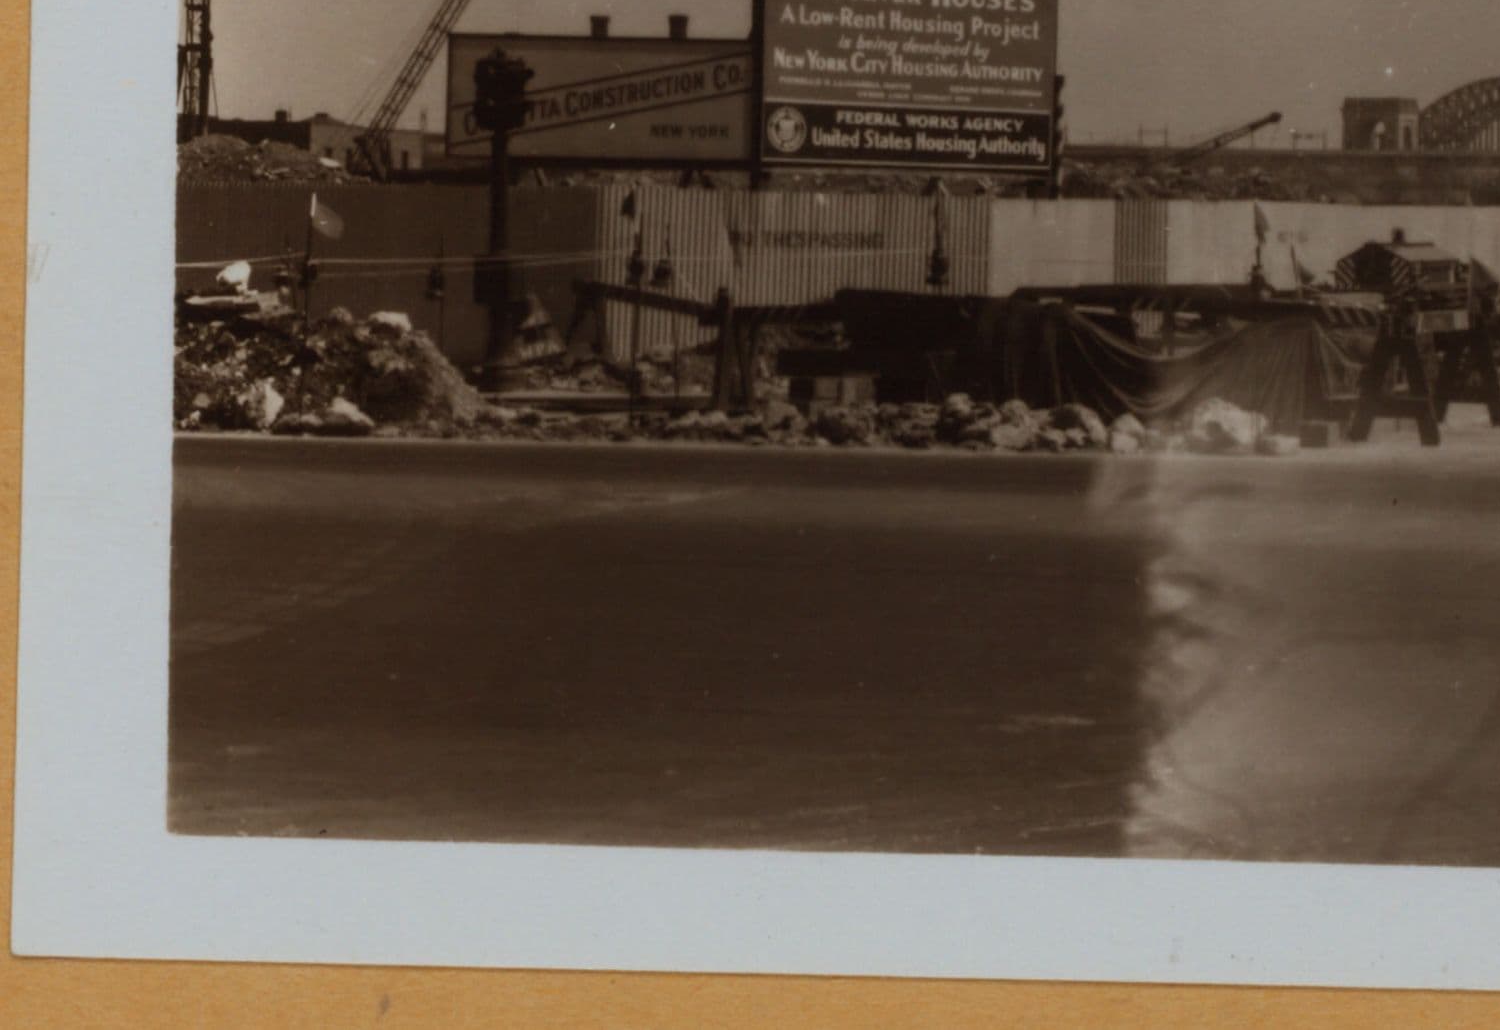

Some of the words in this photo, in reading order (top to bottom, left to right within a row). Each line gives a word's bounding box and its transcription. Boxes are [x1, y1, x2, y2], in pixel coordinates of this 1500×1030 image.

[781, 5, 795, 23] A
[800, 6, 885, 29] Low-Rent
[890, 9, 964, 40] Housing
[971, 17, 1040, 45] Project
[774, 47, 804, 69] NEW
[808, 51, 848, 71] YORK
[851, 52, 888, 74] CITY
[891, 57, 959, 77] HOUSING
[962, 61, 1042, 82] AUTHORITY
[857, 36, 897, 56] being
[902, 38, 969, 59] developed
[973, 41, 990, 62] by
[565, 70, 705, 116] CONSTRUCTION
[713, 64, 745, 90] CO.
[650, 124, 682, 138] NEW
[688, 125, 729, 138] YORK
[836, 111, 900, 126] FEDERAL
[906, 113, 958, 129] WORKS
[963, 117, 1024, 132] AGENCY
[812, 128, 860, 148] United
[864, 131, 912, 150] States
[916, 133, 977, 158] Housing
[978, 135, 1045, 161] Authority
